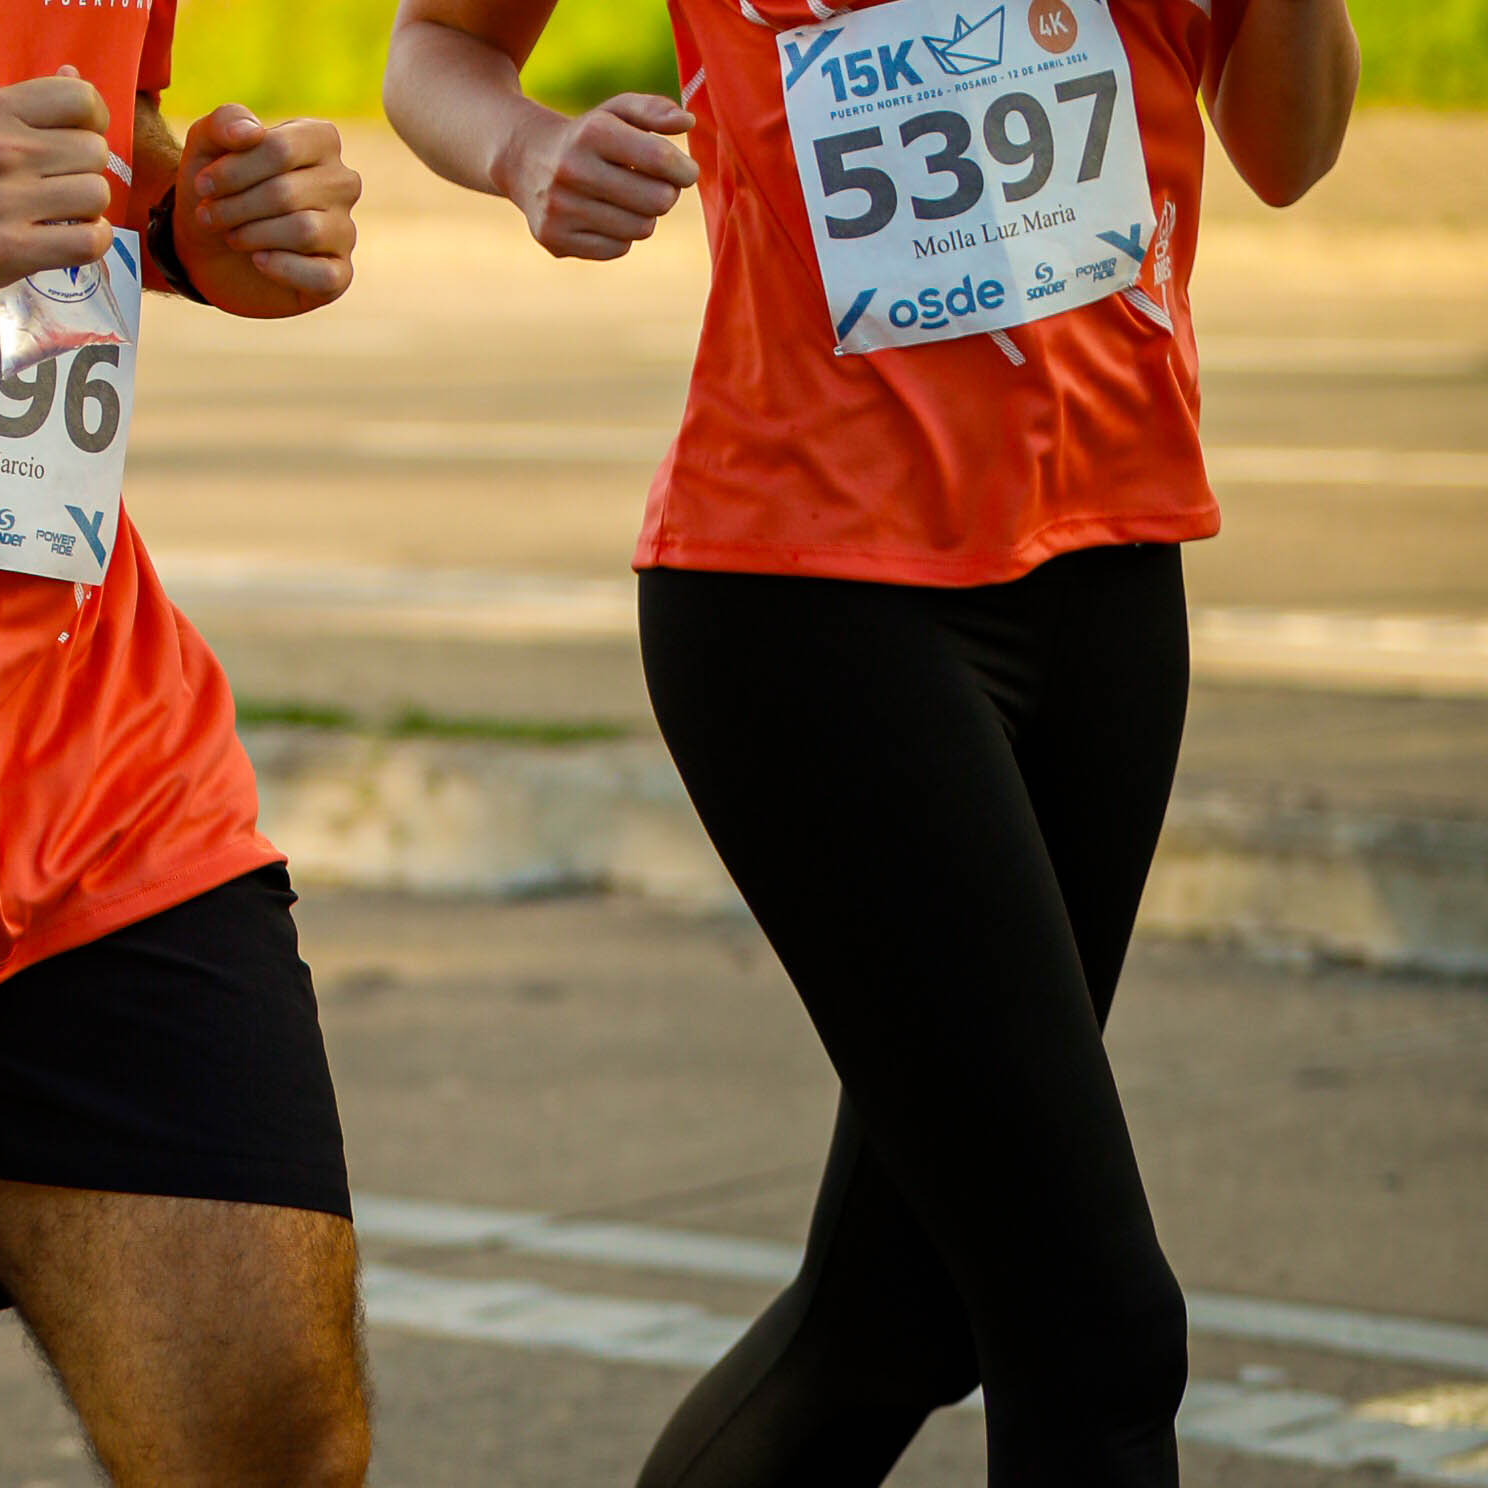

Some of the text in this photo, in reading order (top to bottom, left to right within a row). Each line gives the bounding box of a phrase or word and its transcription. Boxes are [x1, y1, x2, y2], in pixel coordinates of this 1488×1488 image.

[1039, 10, 1069, 37] 4K
[821, 39, 924, 103] 15K
[830, 103, 874, 120] PUERTO
[876, 94, 914, 110] NORTE
[917, 87, 944, 102] 2026
[954, 74, 998, 94] ROSARIO
[1007, 69, 1019, 80] 12
[1022, 65, 1034, 76] DE
[1037, 57, 1065, 73] ABRIL
[812, 69, 1118, 241] 5397
[912, 204, 1077, 260] Molla Luz Maria
[888, 274, 1006, 329] osde
